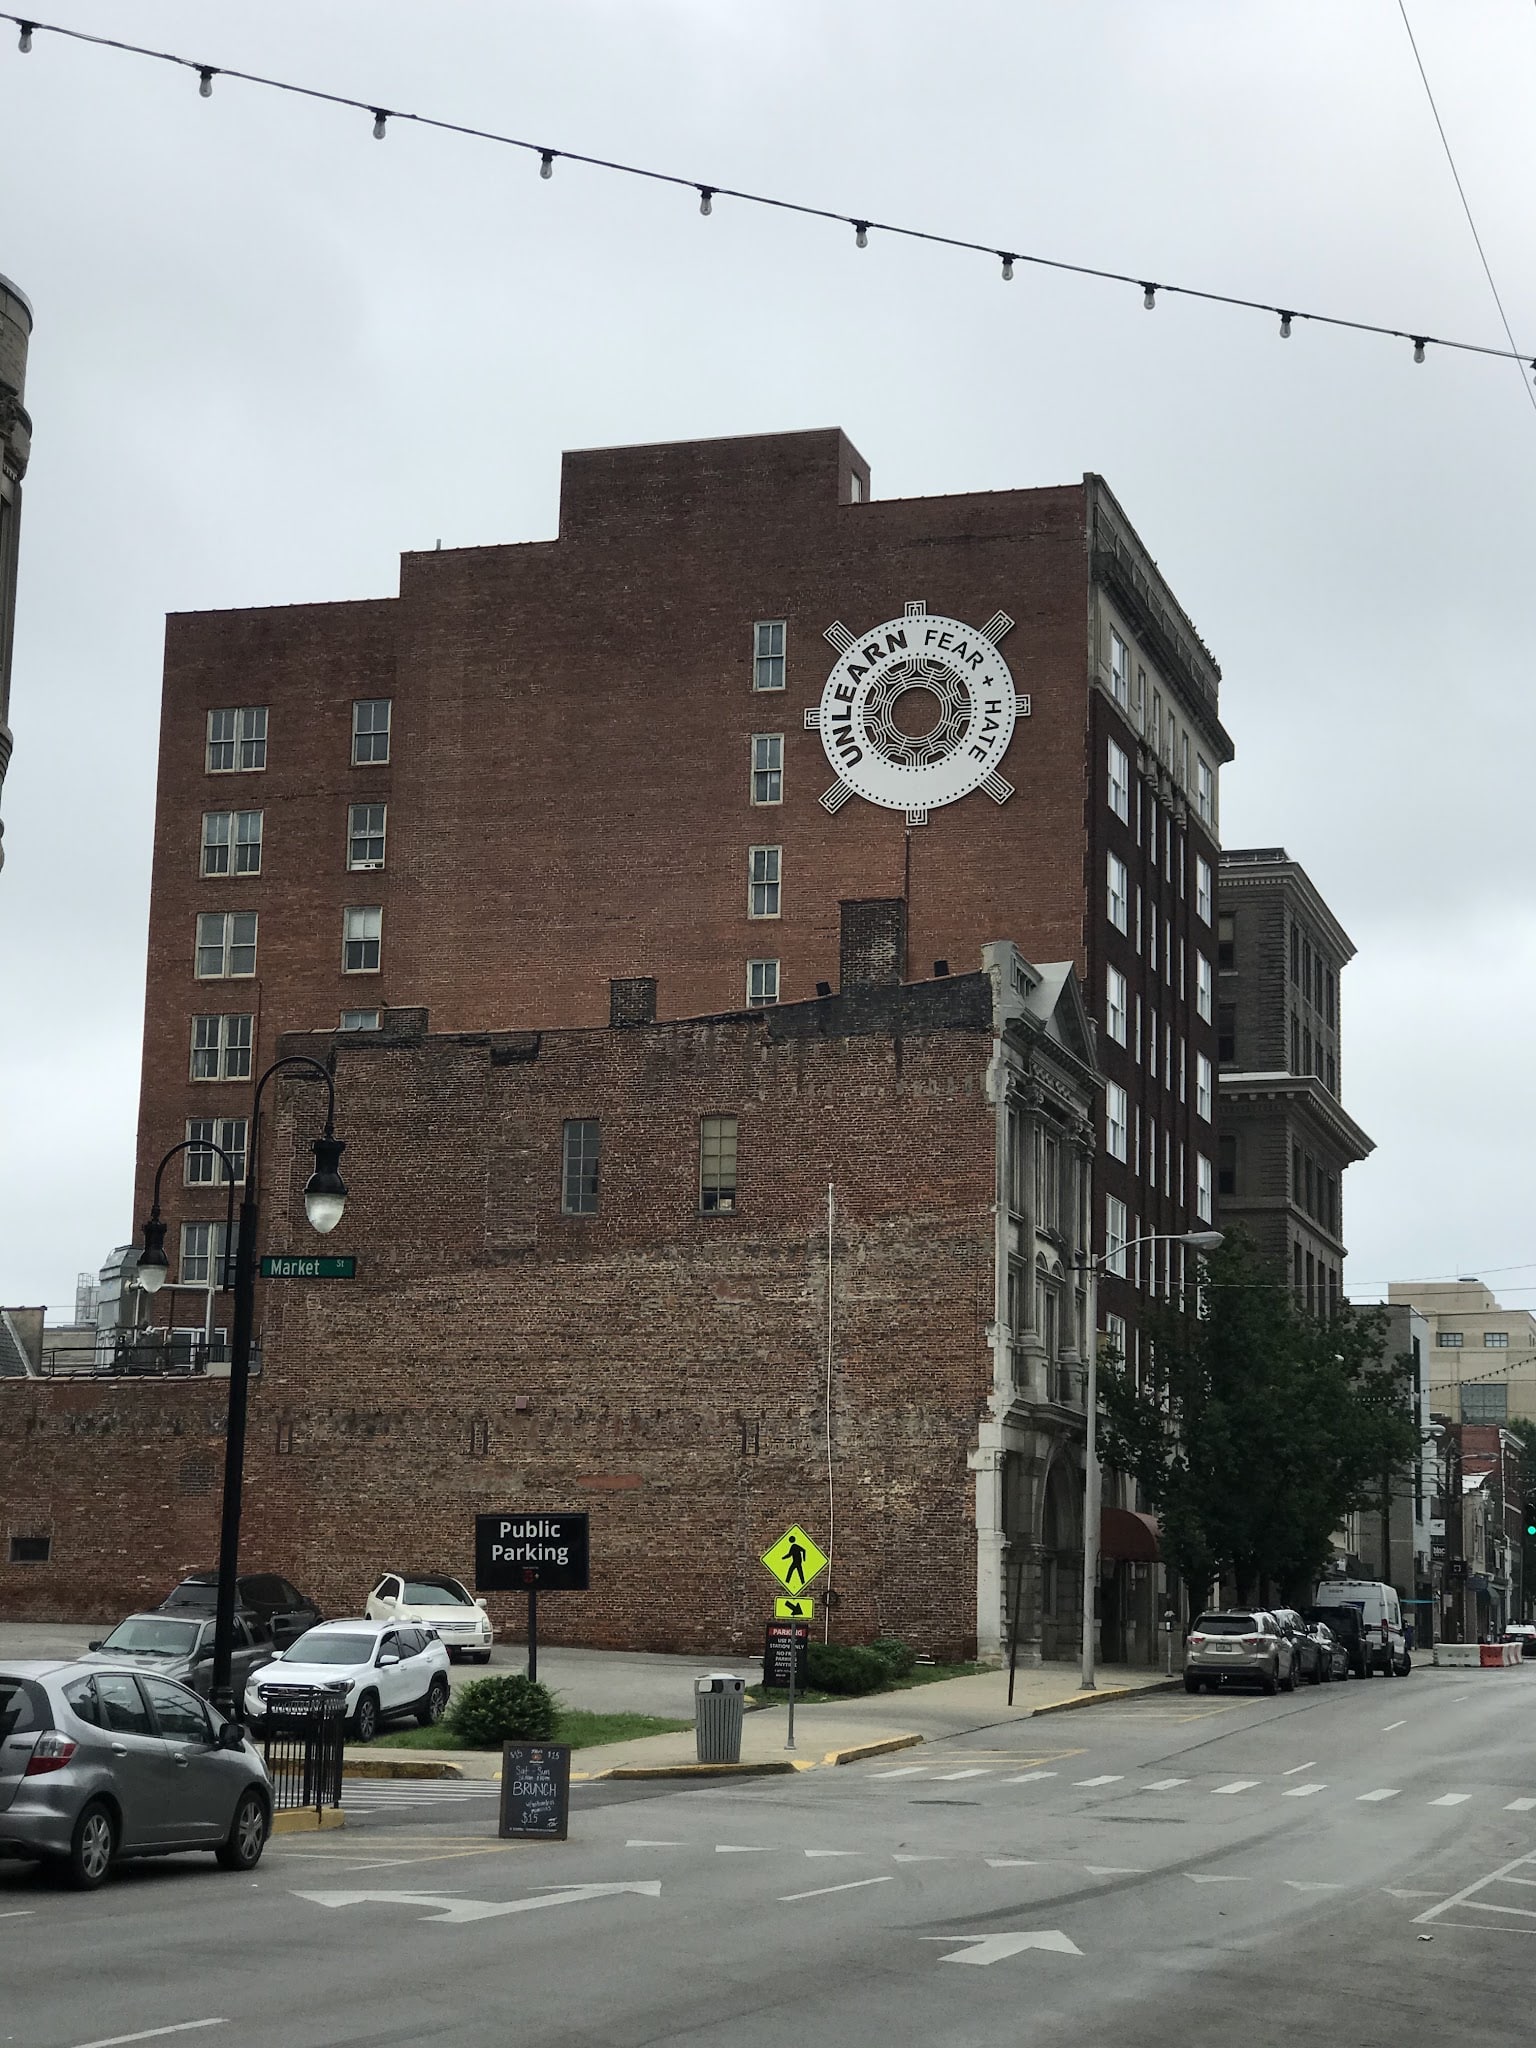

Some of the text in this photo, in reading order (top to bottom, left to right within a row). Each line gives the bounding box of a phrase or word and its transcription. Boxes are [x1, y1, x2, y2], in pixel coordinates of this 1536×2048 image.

[831, 629, 908, 769] UNLEARN
[924, 629, 985, 670] FEAR
[967, 699, 1002, 764] HATE
[270, 1259, 344, 1275] Market St
[500, 1520, 560, 1538] Public
[492, 1543, 569, 1565] Parking
[512, 1781, 556, 1797] BRUNCH
[521, 1811, 538, 1825] $15
